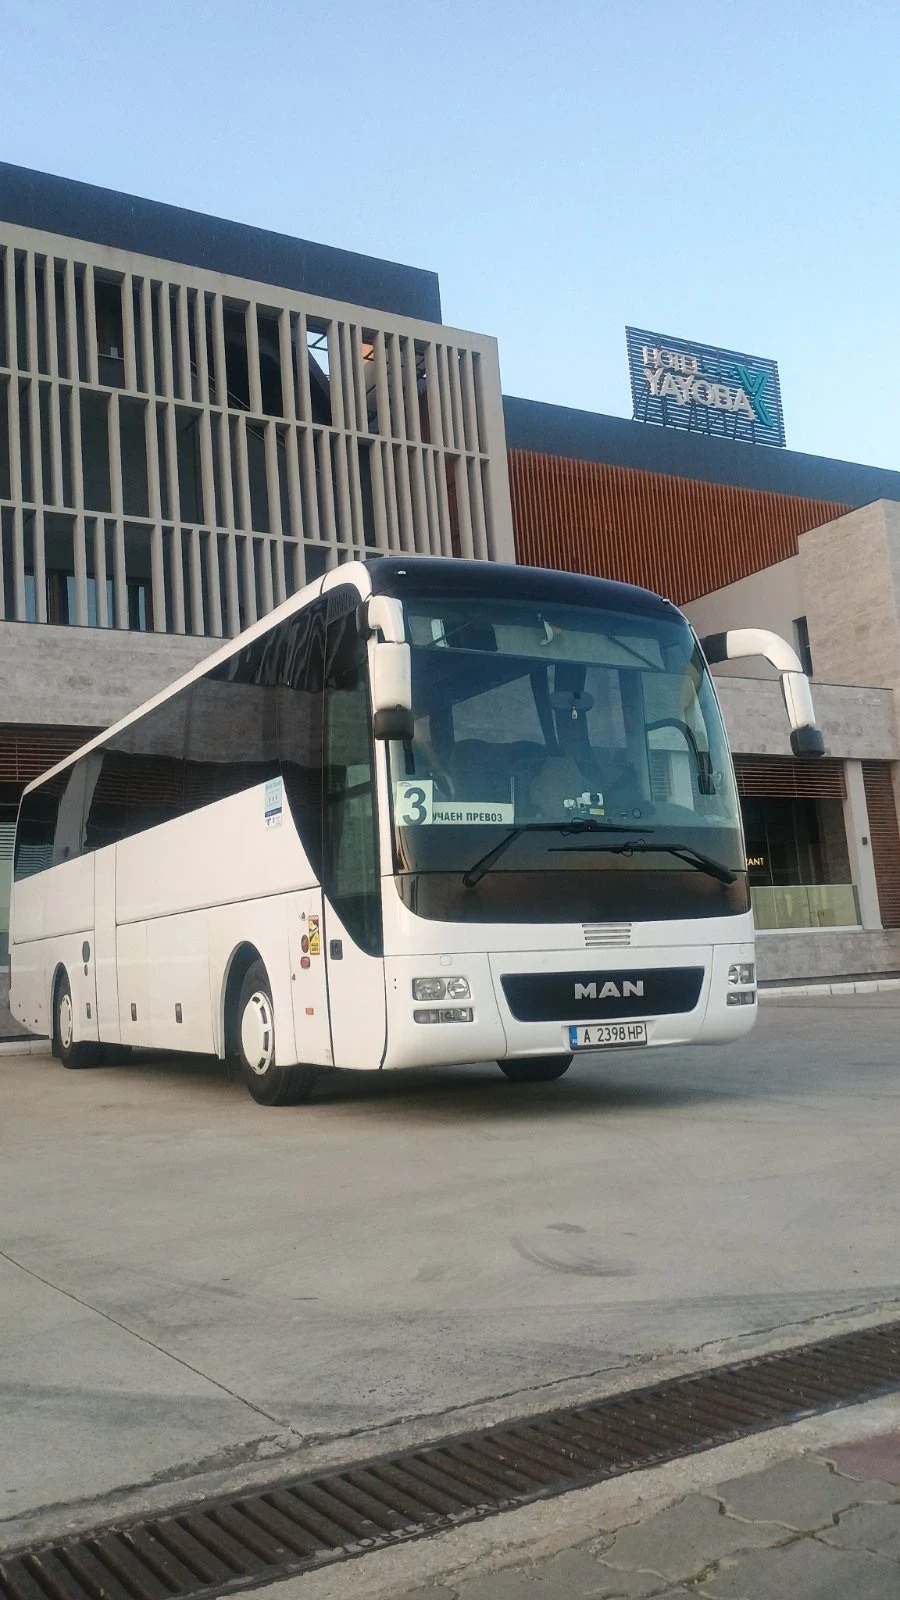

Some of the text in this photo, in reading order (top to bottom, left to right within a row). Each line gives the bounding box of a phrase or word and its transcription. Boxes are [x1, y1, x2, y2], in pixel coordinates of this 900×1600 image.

[642, 346, 702, 376] HOTEL
[643, 367, 755, 420] YAYOBA
[402, 787, 428, 825] 3
[466, 812, 503, 822] ПРЕВОЗ
[574, 980, 644, 1000] MAN
